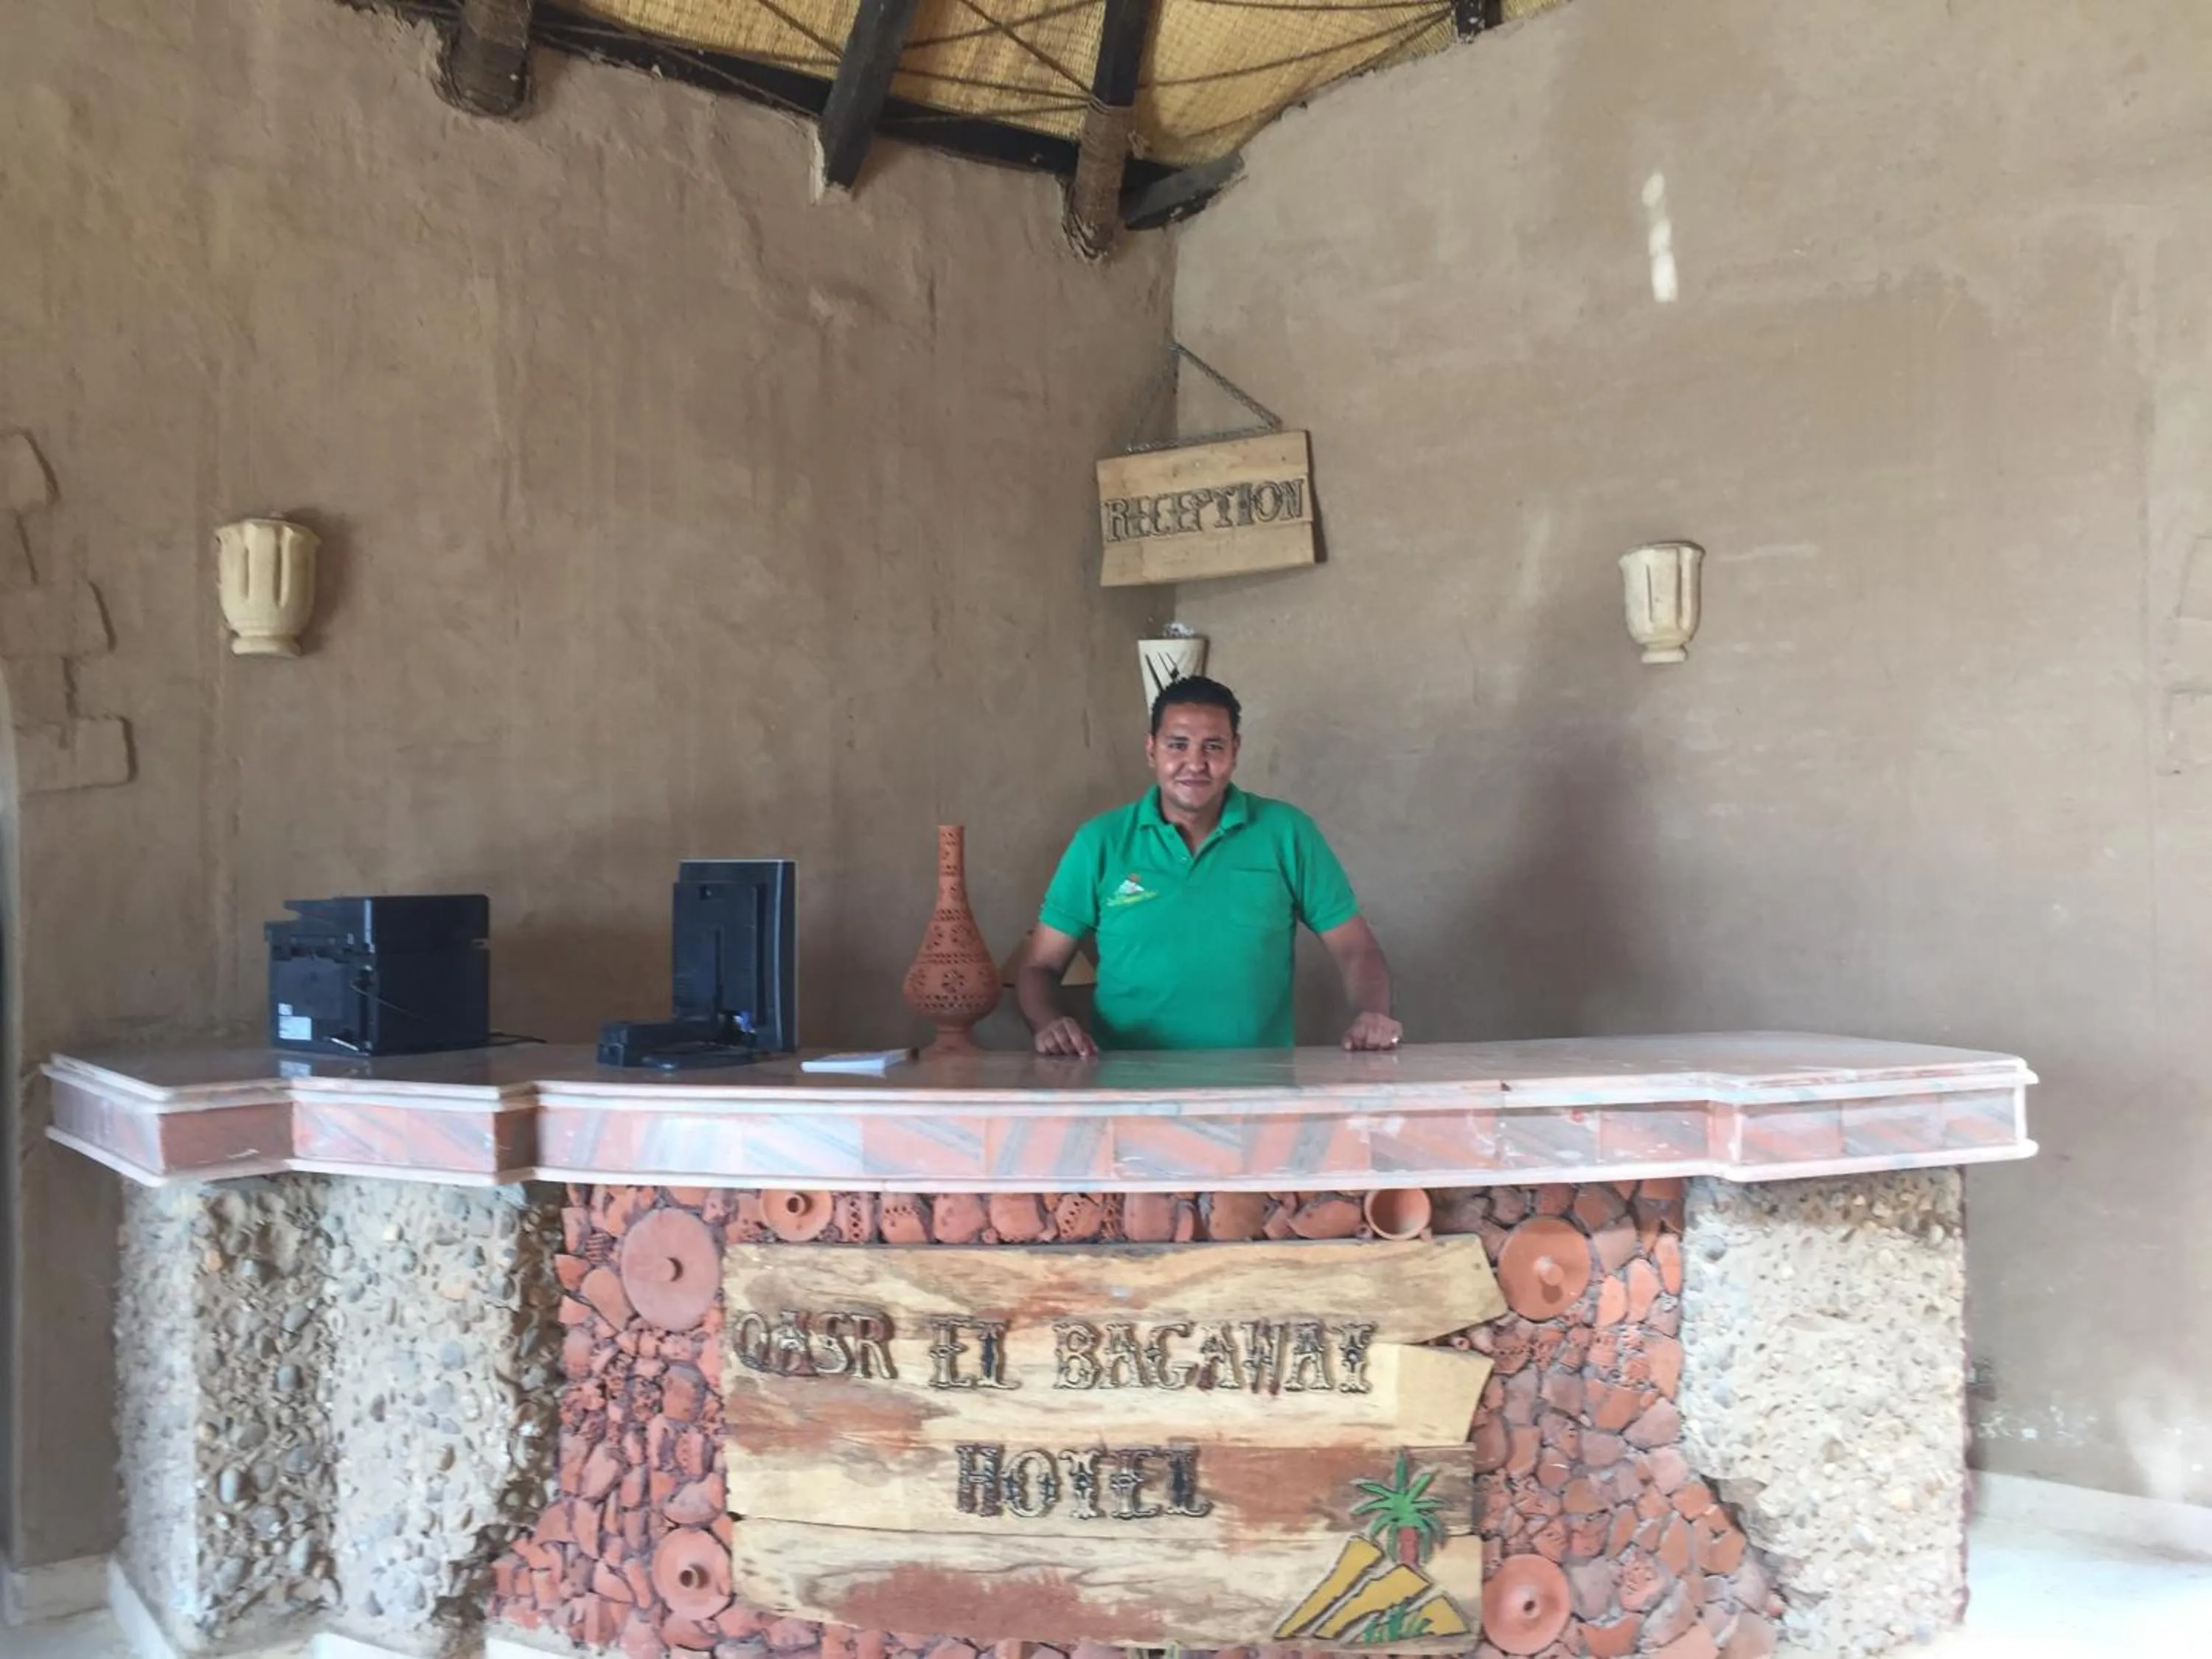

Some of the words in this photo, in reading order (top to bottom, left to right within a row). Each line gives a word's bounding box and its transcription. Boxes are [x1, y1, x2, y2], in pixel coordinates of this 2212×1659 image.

[1105, 479, 1305, 542] RECEPTION
[735, 1309, 899, 1379] QASR
[928, 1315, 1022, 1390] EL
[956, 1441, 1214, 1520] HOTEL
